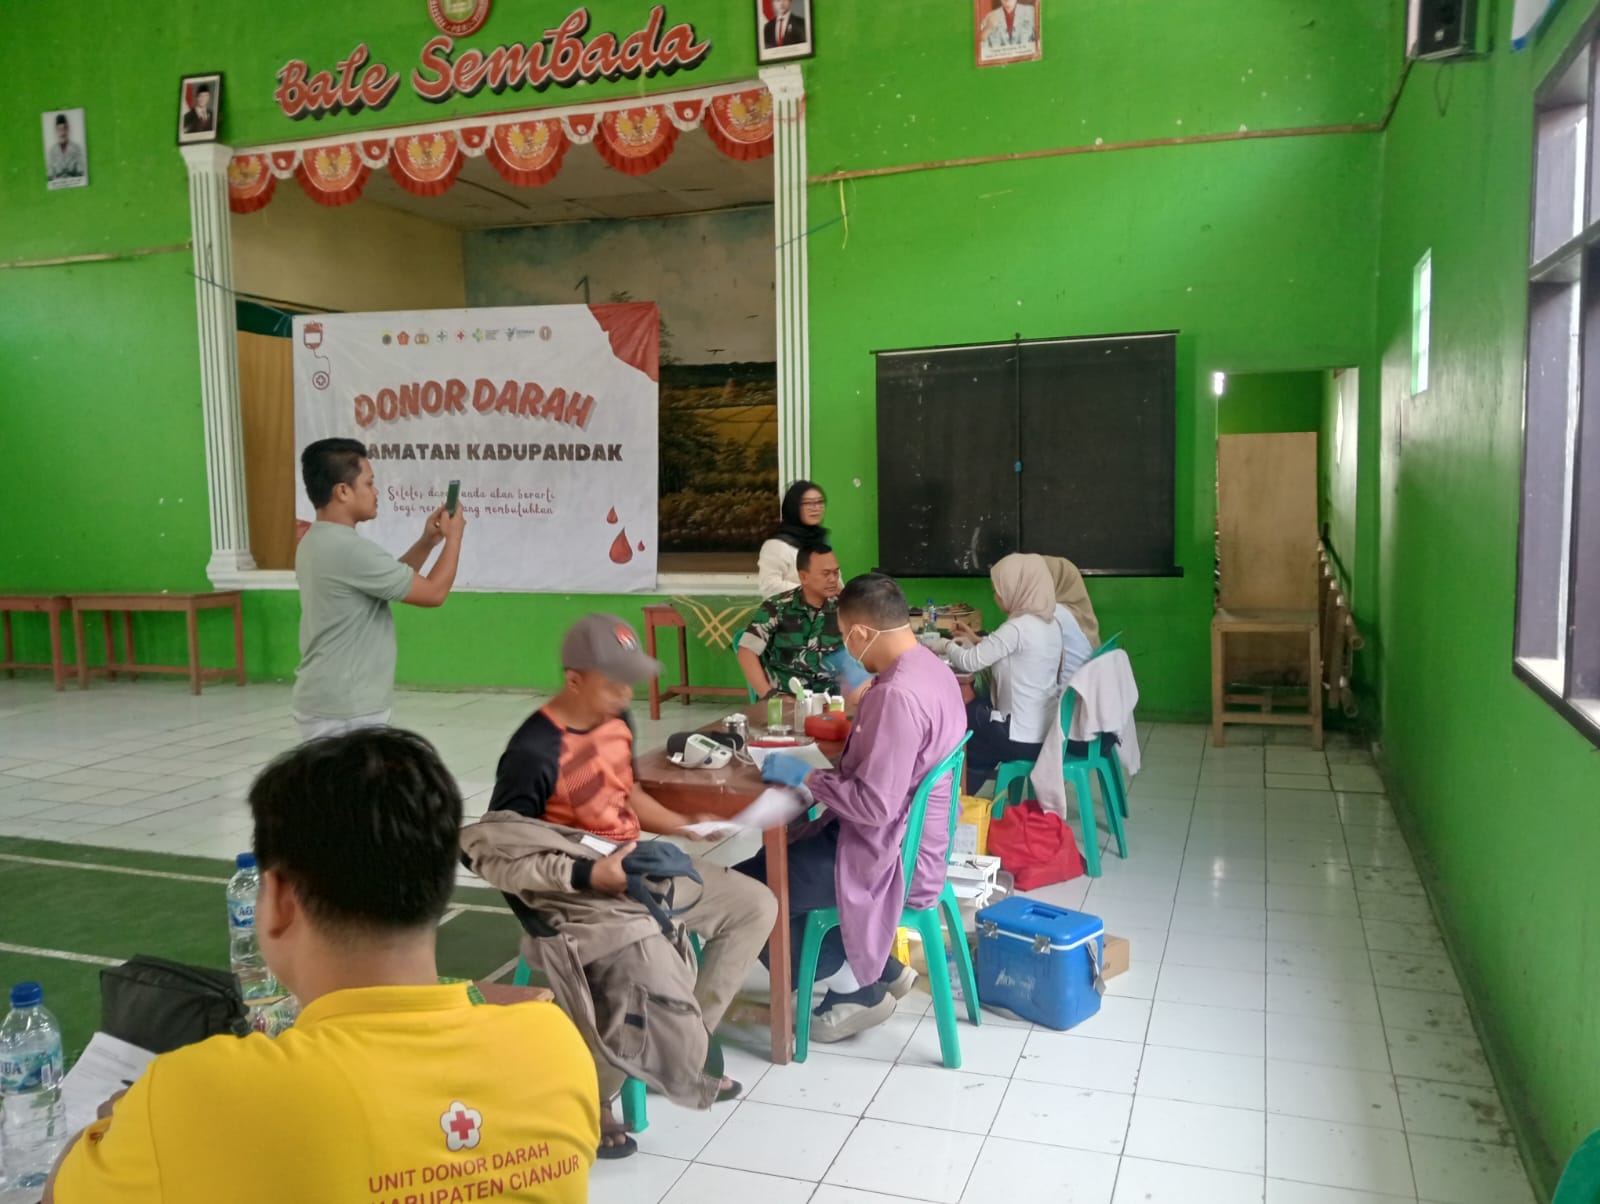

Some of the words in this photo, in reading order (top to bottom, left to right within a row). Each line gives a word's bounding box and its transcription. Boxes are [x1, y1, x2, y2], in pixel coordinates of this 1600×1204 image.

[413, 5, 711, 103] Sembada
[354, 378, 469, 428] DONOR
[472, 378, 595, 431] DARAH
[367, 443, 461, 461] AMATAN
[467, 443, 623, 462] KADUPANDAK
[463, 506, 480, 518] ang
[484, 502, 553, 517] membutuhkan
[490, 487, 514, 499] akan
[369, 1170, 416, 1193] UNIT
[422, 1158, 488, 1184] DONOR
[491, 1142, 550, 1170] DARAH
[509, 1154, 580, 1191] CIANJUR
